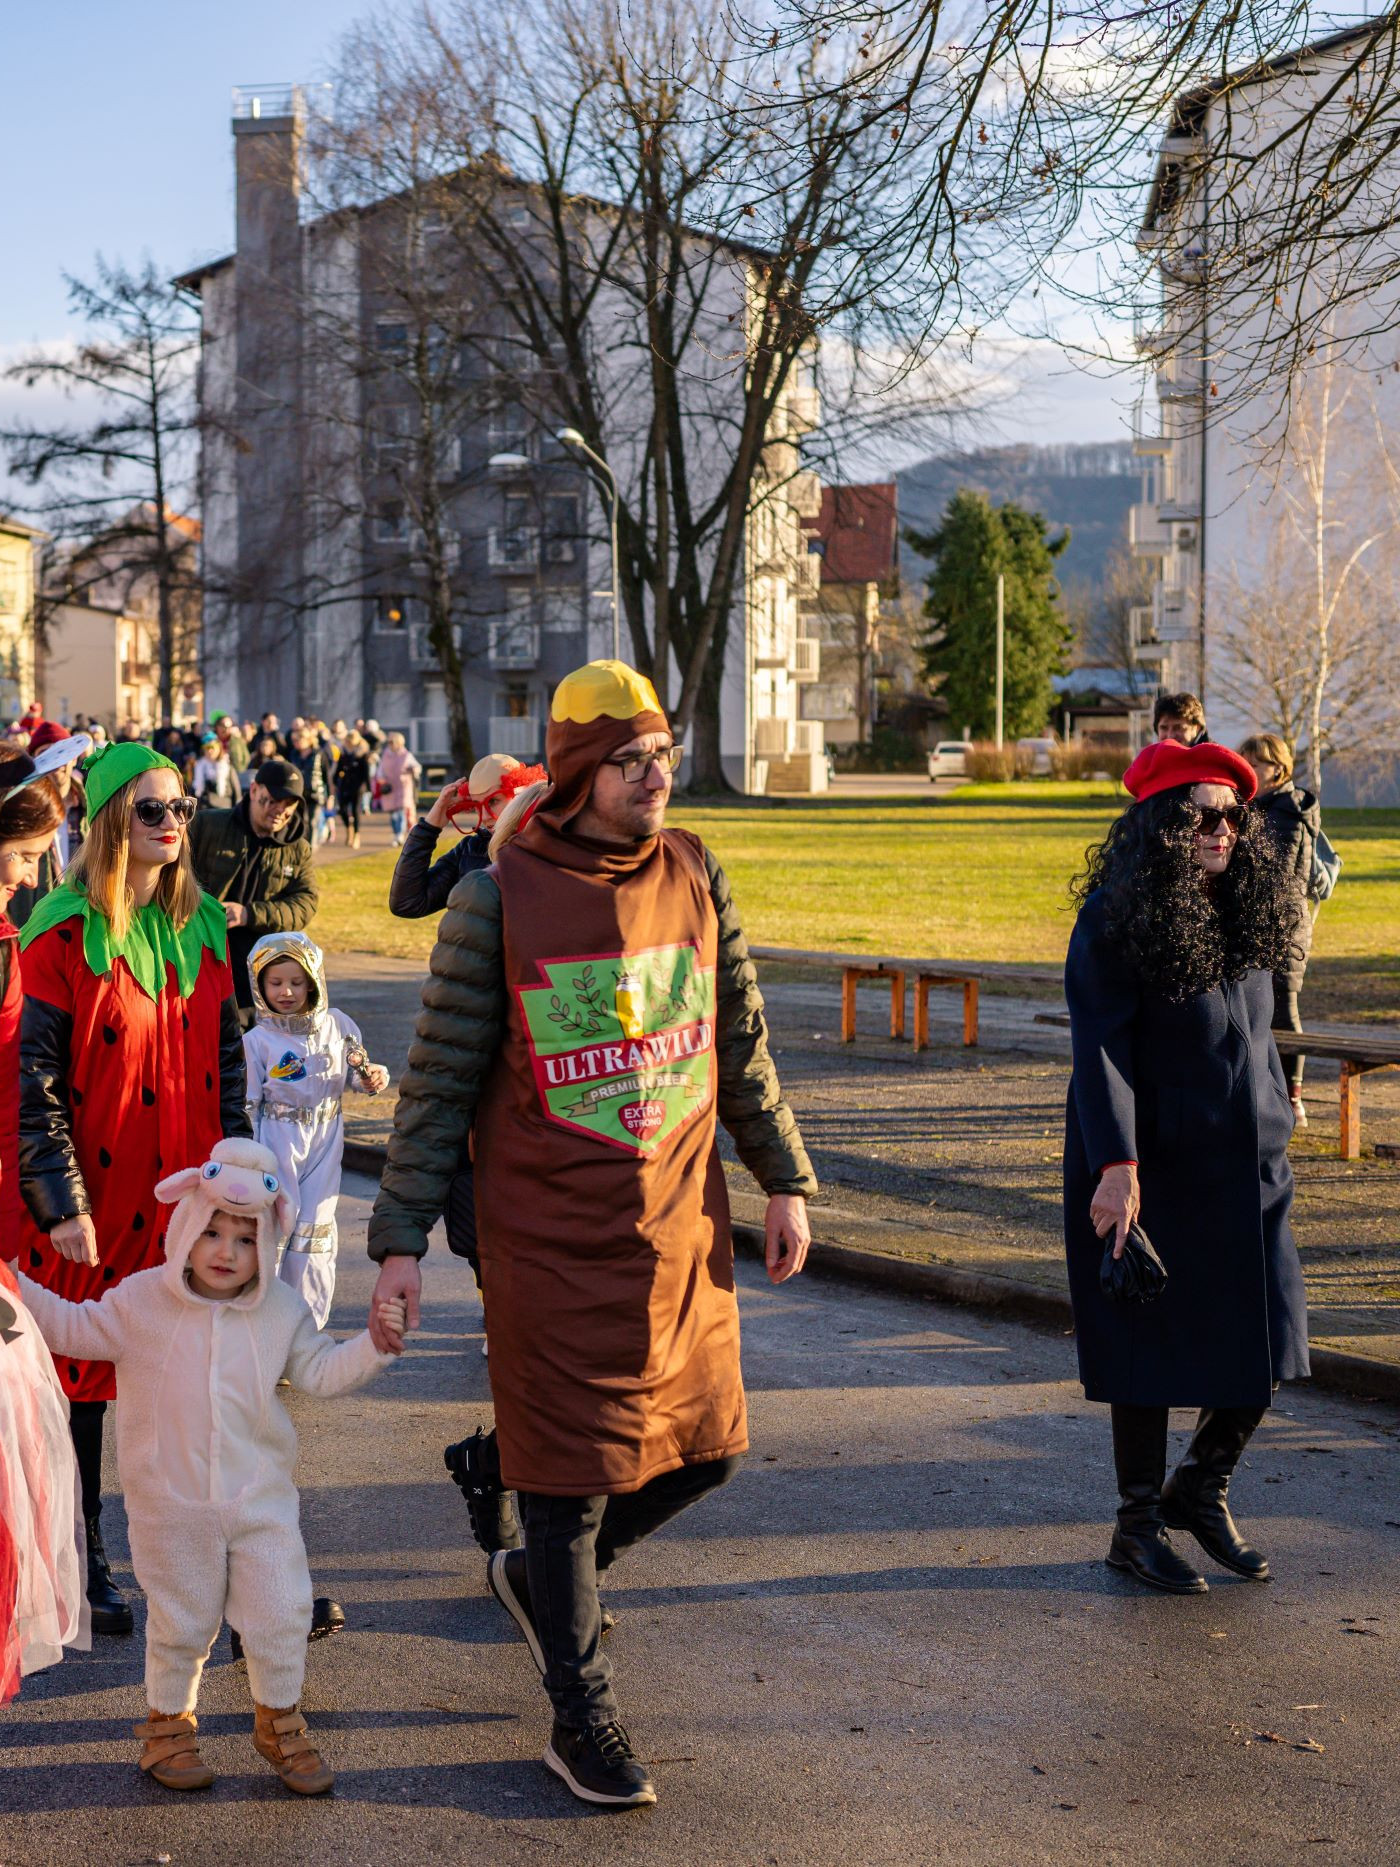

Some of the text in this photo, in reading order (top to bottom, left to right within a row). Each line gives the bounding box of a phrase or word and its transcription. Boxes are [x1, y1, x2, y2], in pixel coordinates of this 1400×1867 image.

[544, 1023, 712, 1084] ULTRA WILD
[656, 1073, 689, 1087] BEER
[624, 1105, 662, 1119] EXTRA
[627, 1117, 662, 1129] STRONG
